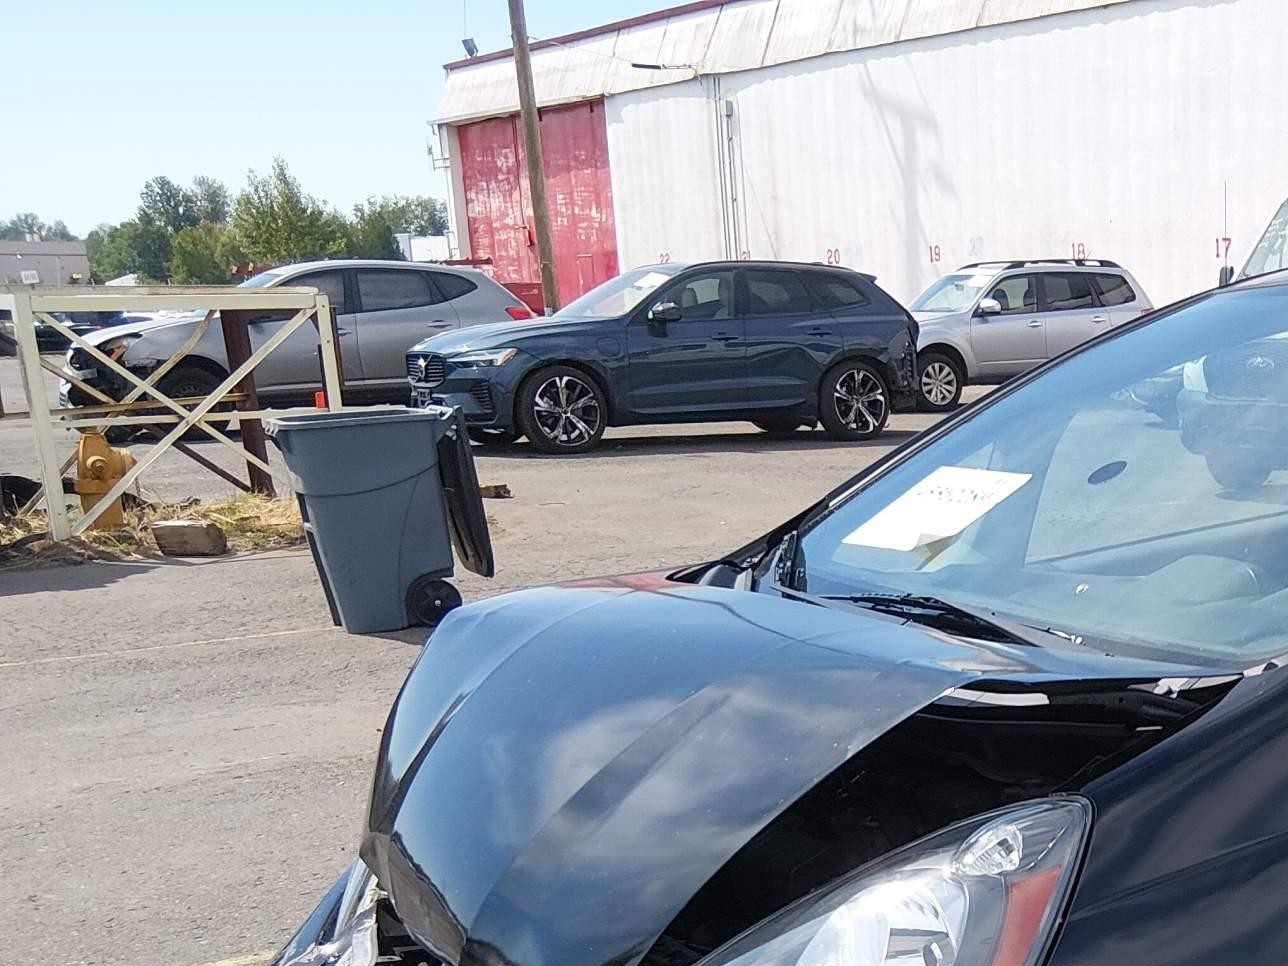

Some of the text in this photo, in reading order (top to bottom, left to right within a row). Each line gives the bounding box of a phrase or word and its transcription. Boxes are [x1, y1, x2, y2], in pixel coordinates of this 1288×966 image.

[827, 248, 841, 265] 20
[929, 245, 941, 263] 19
[1072, 242, 1086, 260] 18
[1215, 237, 1232, 258] 17
